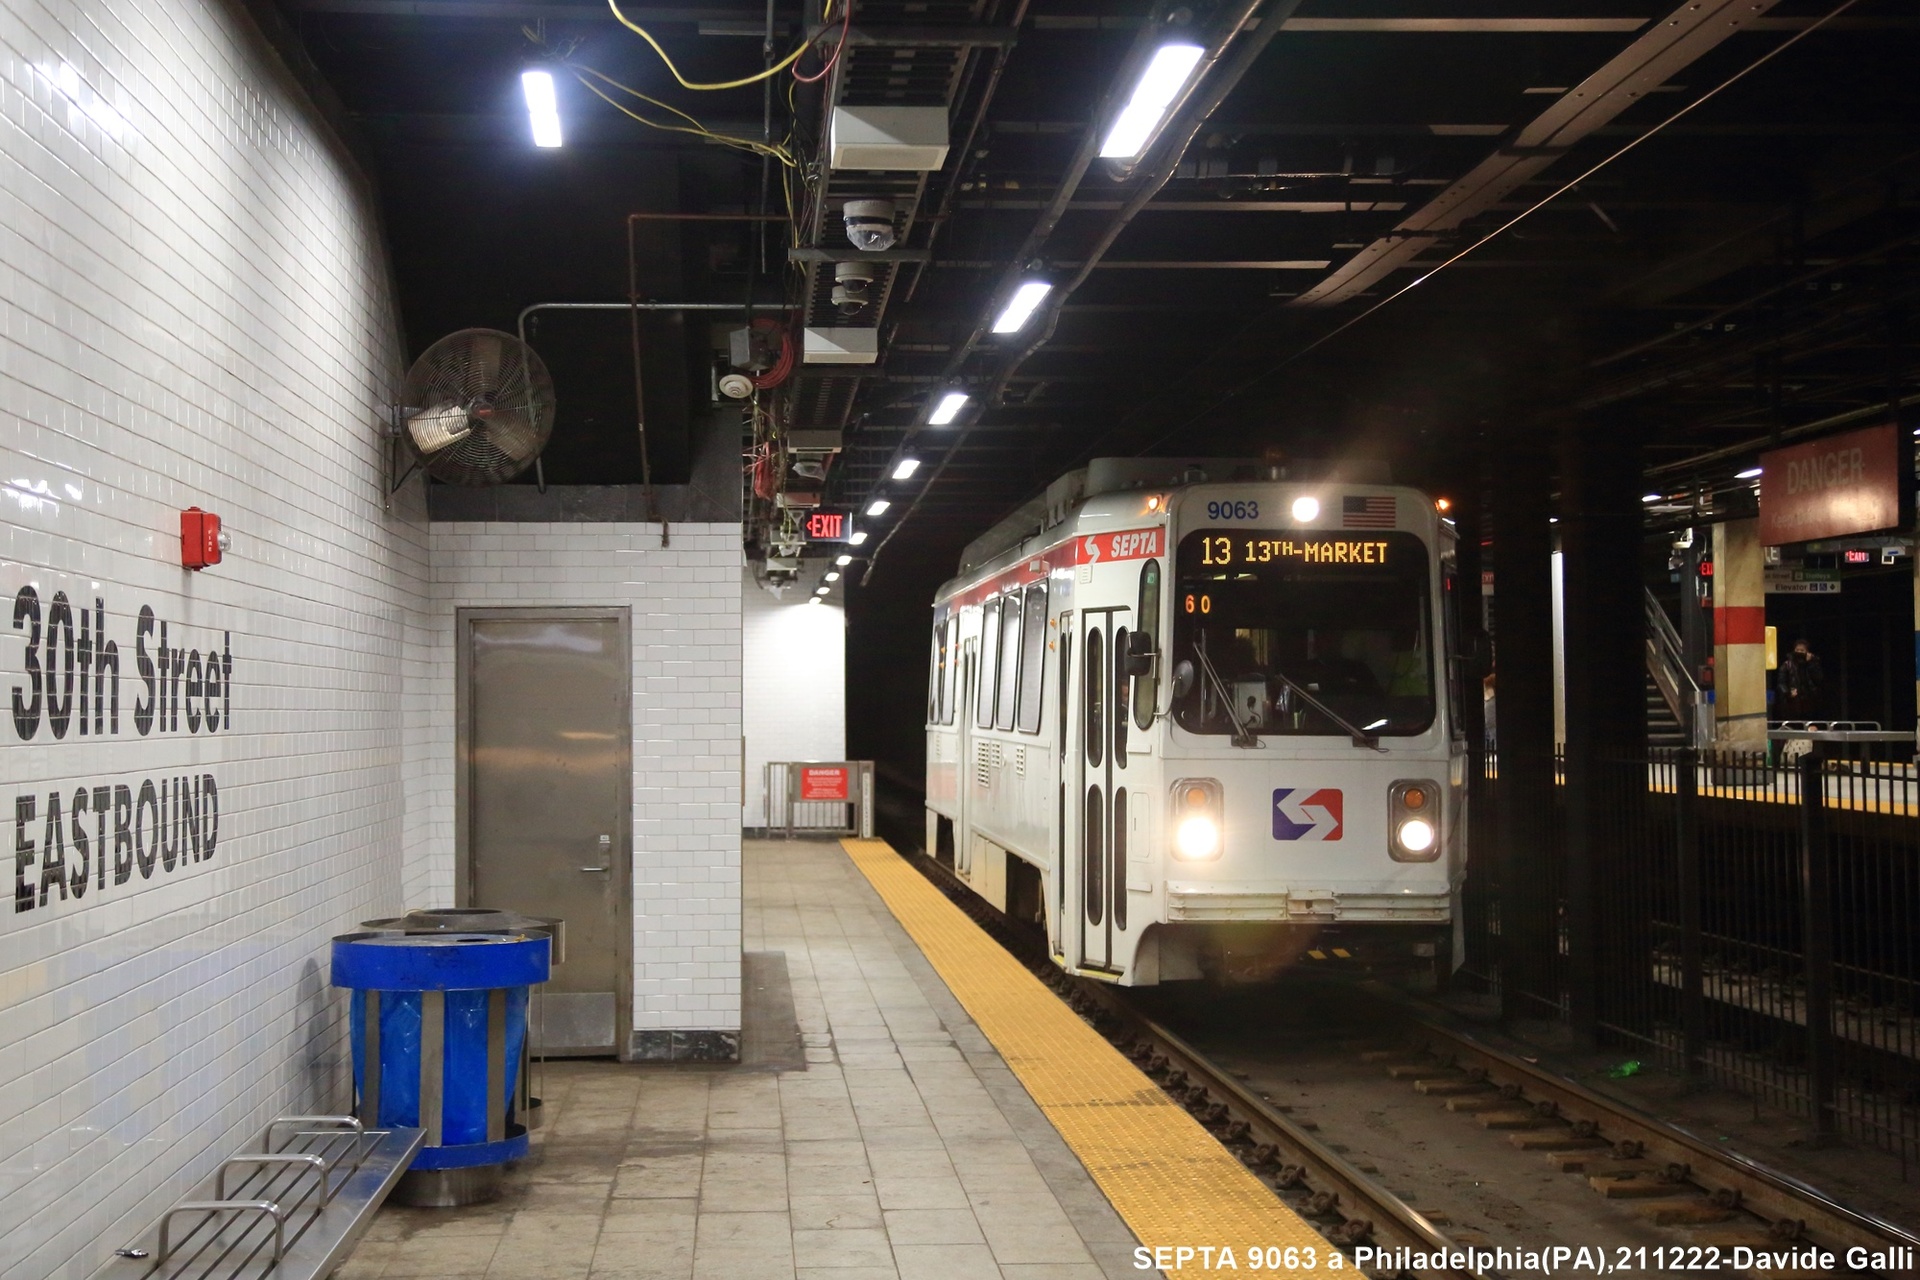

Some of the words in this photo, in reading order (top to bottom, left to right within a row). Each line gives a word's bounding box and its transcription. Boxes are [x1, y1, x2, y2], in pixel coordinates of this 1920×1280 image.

[1787, 447, 1863, 495] DANGER
[1208, 501, 1259, 520] 9063
[811, 514, 843, 538] EXIT
[1111, 531, 1157, 558] SEPTA
[1202, 537, 1231, 565] 13
[1245, 541, 1388, 564] 13TH-MARKET
[1775, 583, 1807, 591] Elevator
[12, 585, 120, 741] 30th
[134, 604, 232, 736] Street
[15, 774, 219, 914] EASTBOUND
